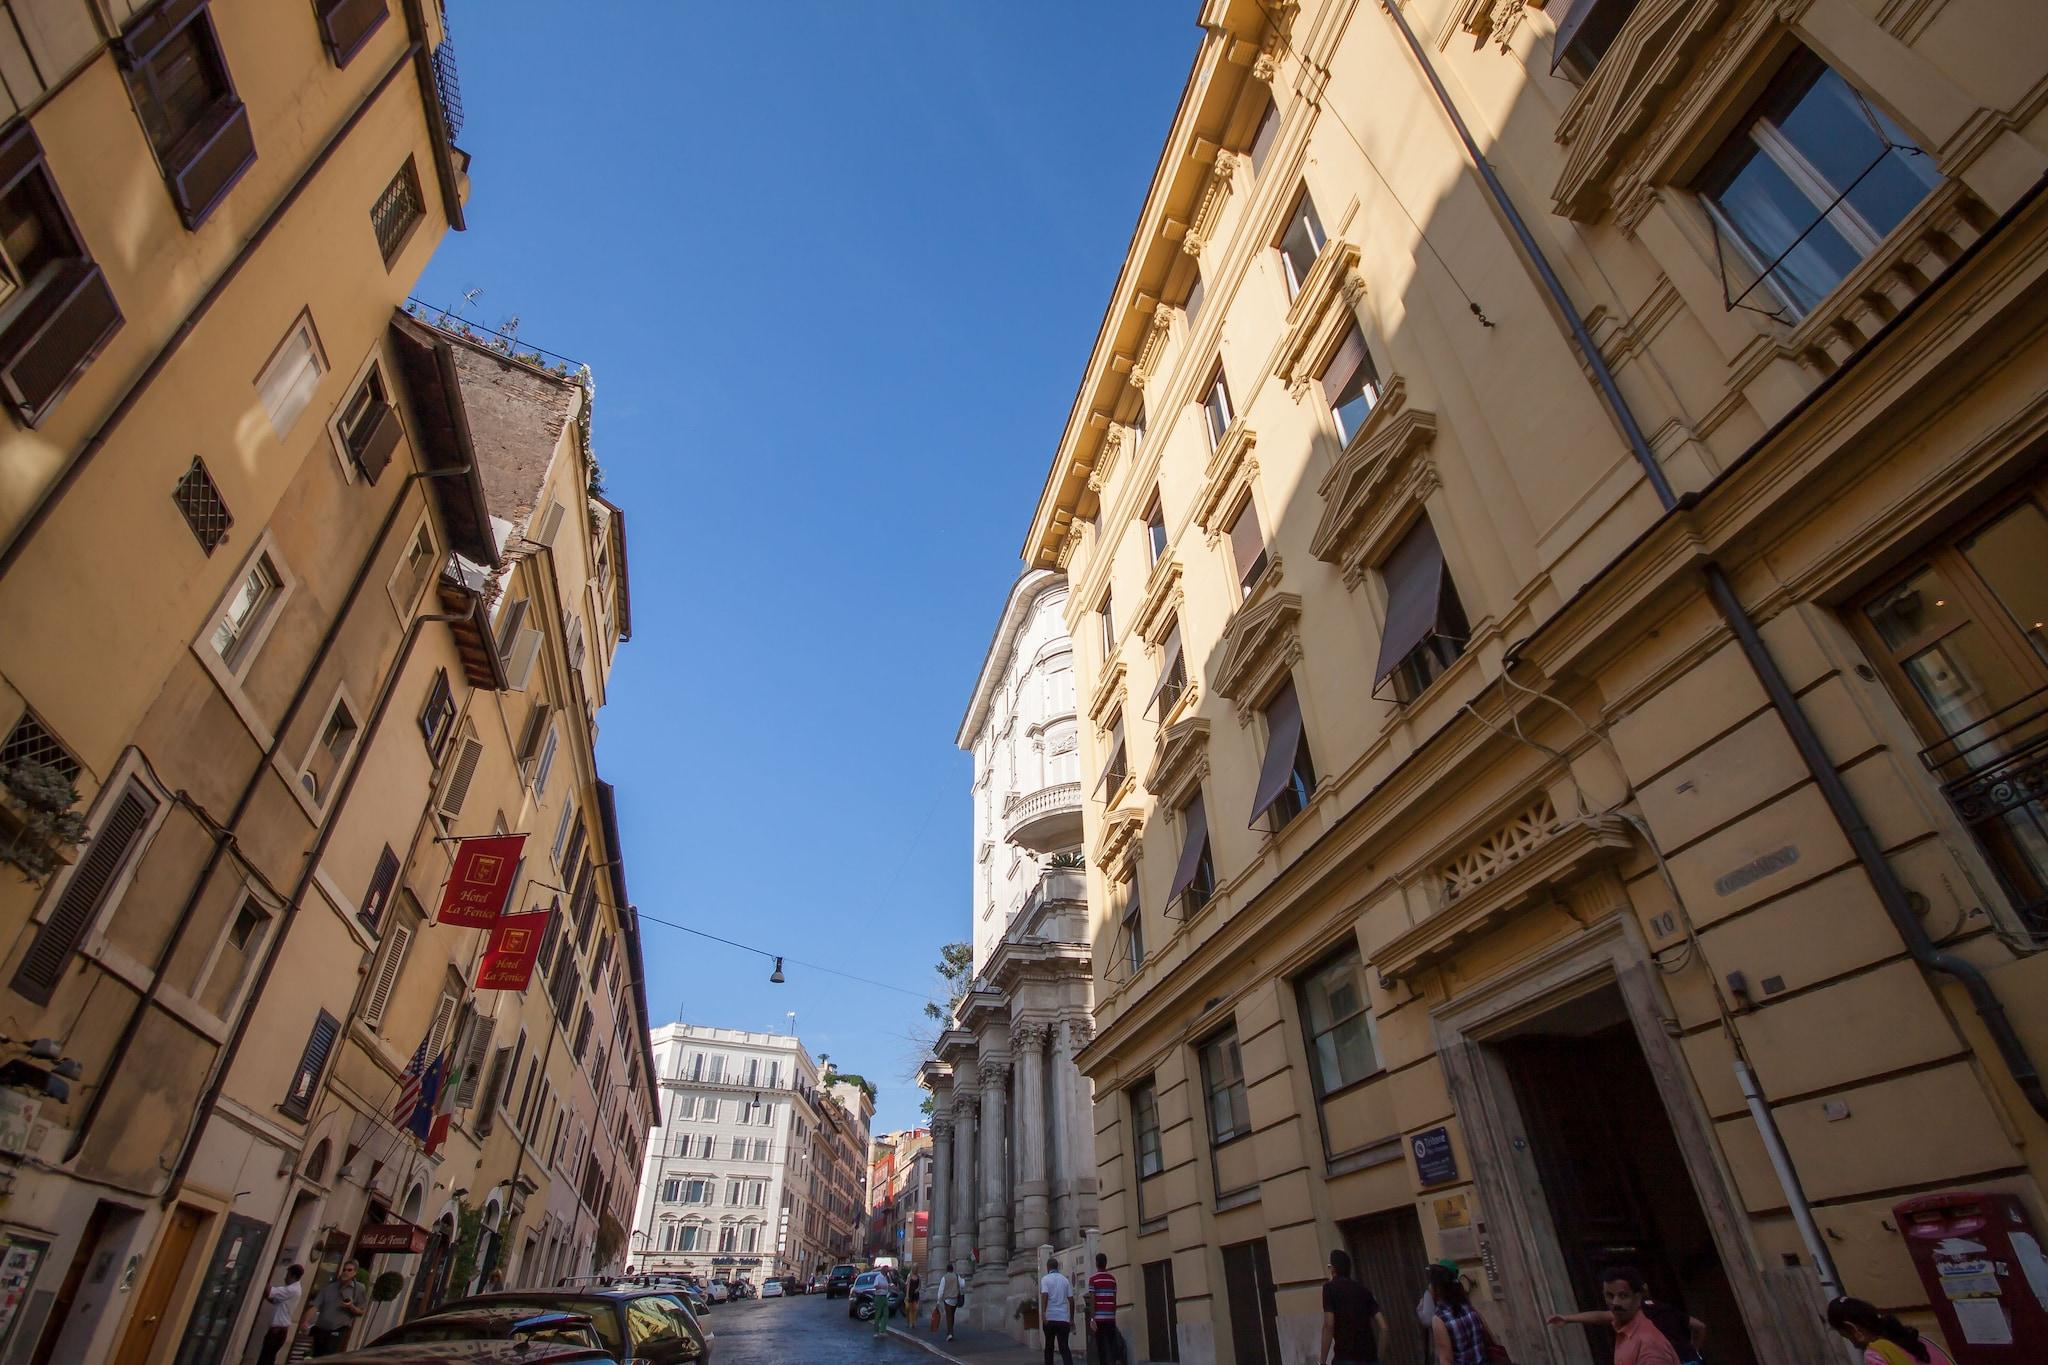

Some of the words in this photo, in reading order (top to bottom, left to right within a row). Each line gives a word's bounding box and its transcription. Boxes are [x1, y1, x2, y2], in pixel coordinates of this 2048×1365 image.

[460, 889, 488, 904] Hotel
[446, 903, 460, 914] La
[463, 906, 496, 920] Fenice
[1653, 911, 1674, 937] 10
[495, 958, 520, 969] Hotel
[484, 972, 497, 981] La
[497, 971, 526, 982] Fenice
